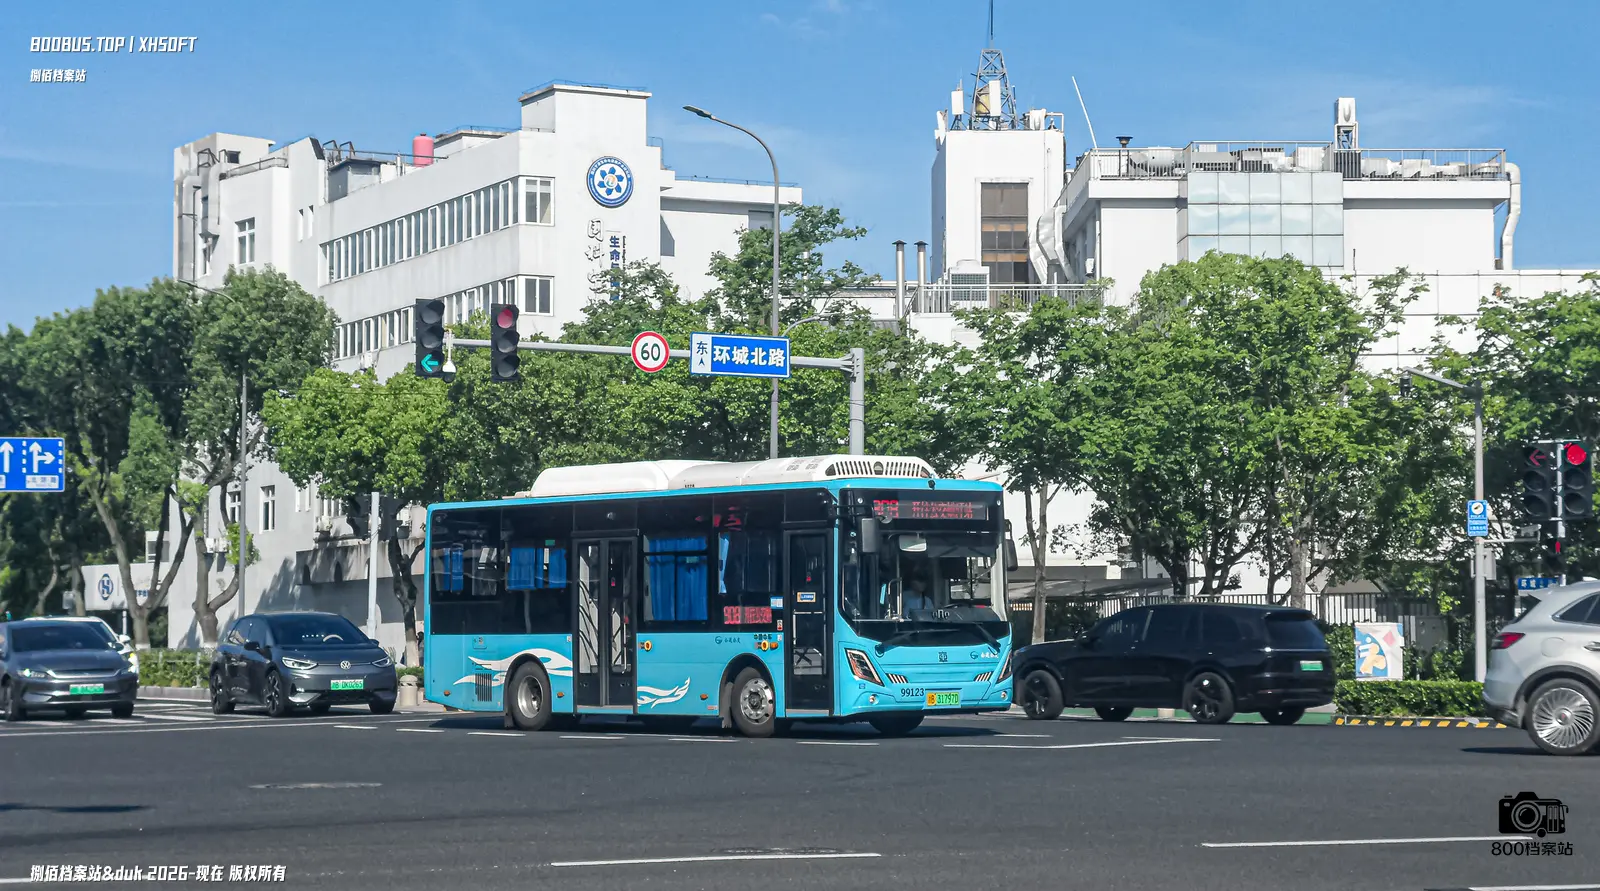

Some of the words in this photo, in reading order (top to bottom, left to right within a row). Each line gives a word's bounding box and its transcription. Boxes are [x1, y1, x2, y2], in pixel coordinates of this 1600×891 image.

[641, 342, 661, 362] 60
[696, 341, 709, 356] 东
[713, 345, 785, 367] 环城北路
[901, 688, 925, 697] 99123
